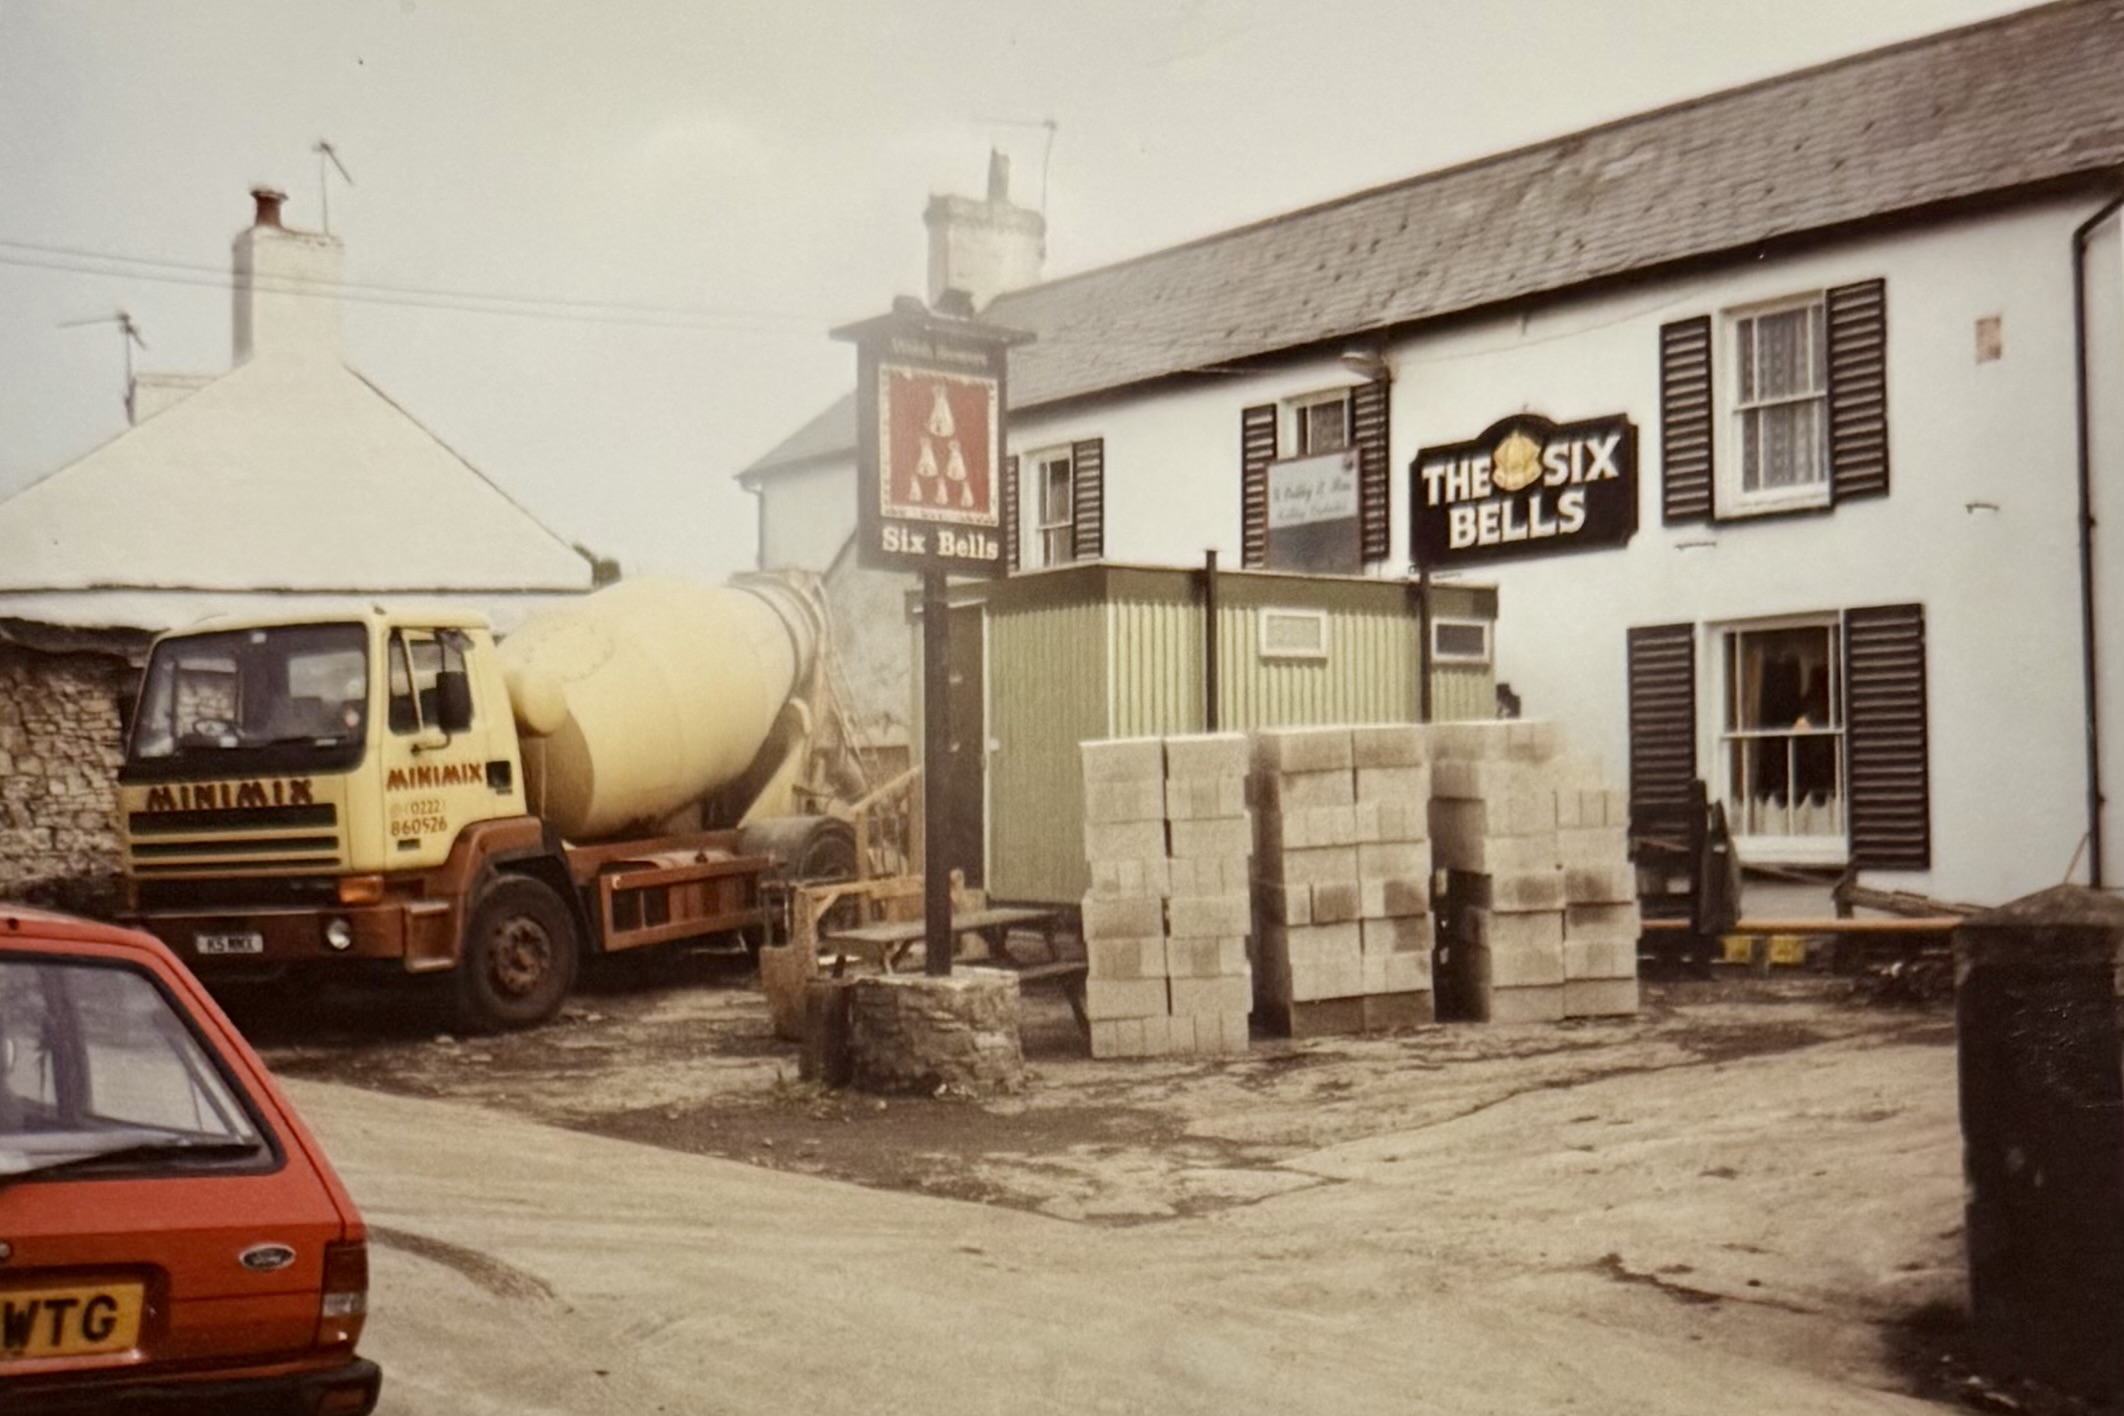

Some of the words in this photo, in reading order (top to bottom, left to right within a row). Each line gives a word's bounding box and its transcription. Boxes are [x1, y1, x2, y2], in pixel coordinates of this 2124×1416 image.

[1422, 455, 1492, 506] THE
[1543, 434, 1621, 486] SIX
[1450, 489, 1585, 549] BELLS
[882, 525, 926, 555] Six
[937, 529, 999, 560] Bells
[146, 778, 313, 812] MINIMIX
[386, 762, 483, 791] MINIMIX
[3, 1294, 118, 1350] WTG
